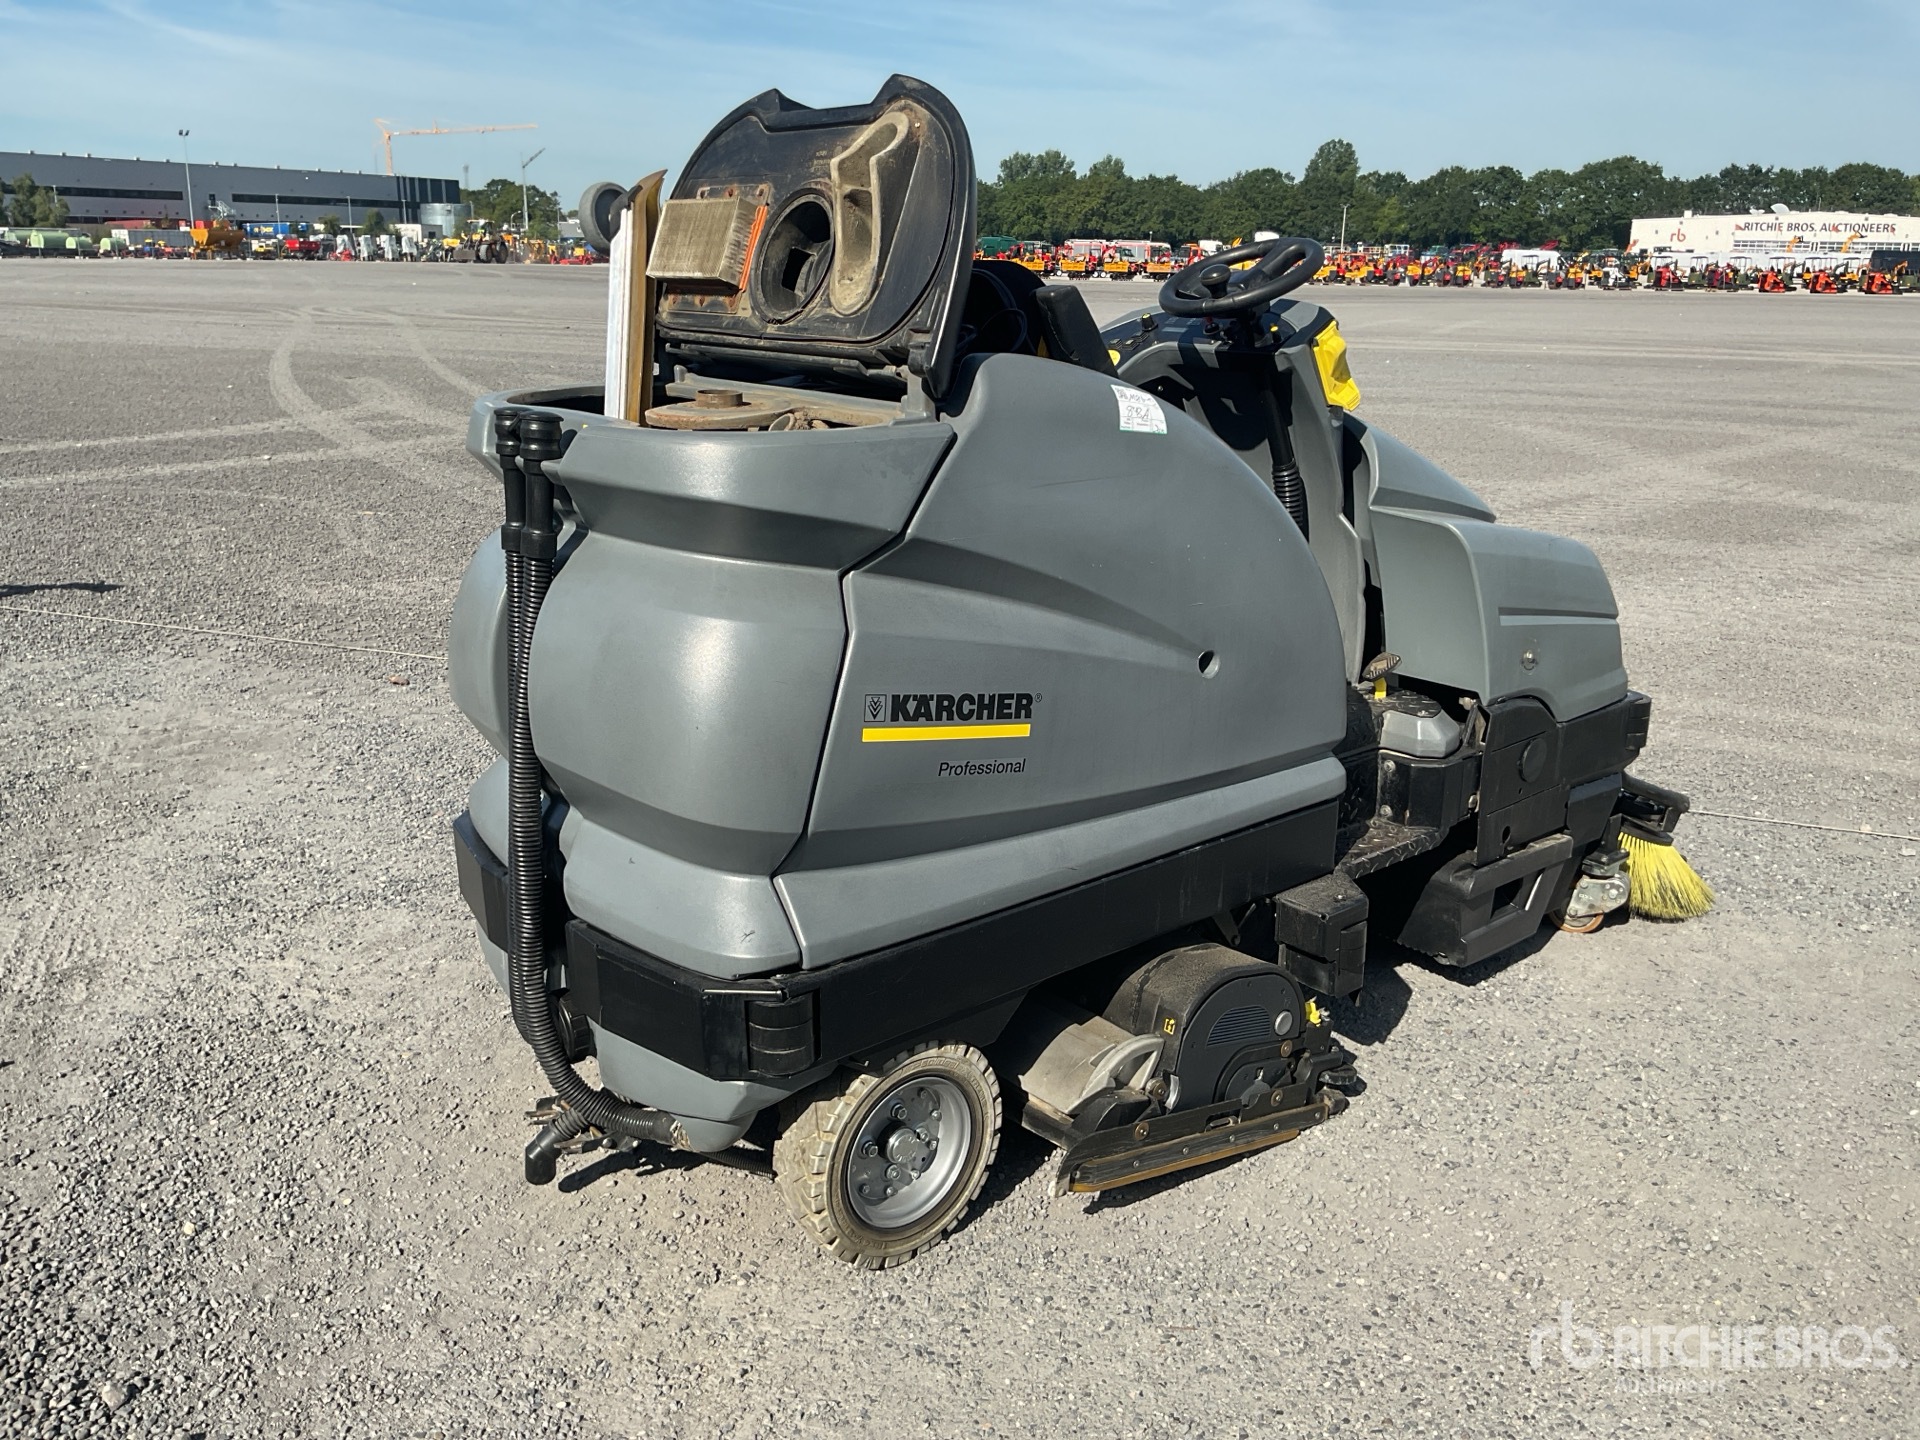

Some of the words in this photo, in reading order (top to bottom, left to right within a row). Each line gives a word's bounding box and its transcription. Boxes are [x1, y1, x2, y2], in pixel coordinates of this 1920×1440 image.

[1743, 222, 1783, 232] RITCHIE
[1787, 222, 1816, 232] BROS.
[1820, 222, 1896, 233] AUCTIONEERS
[890, 693, 1033, 722] KÄRCHER
[938, 758, 1026, 776] Professional
